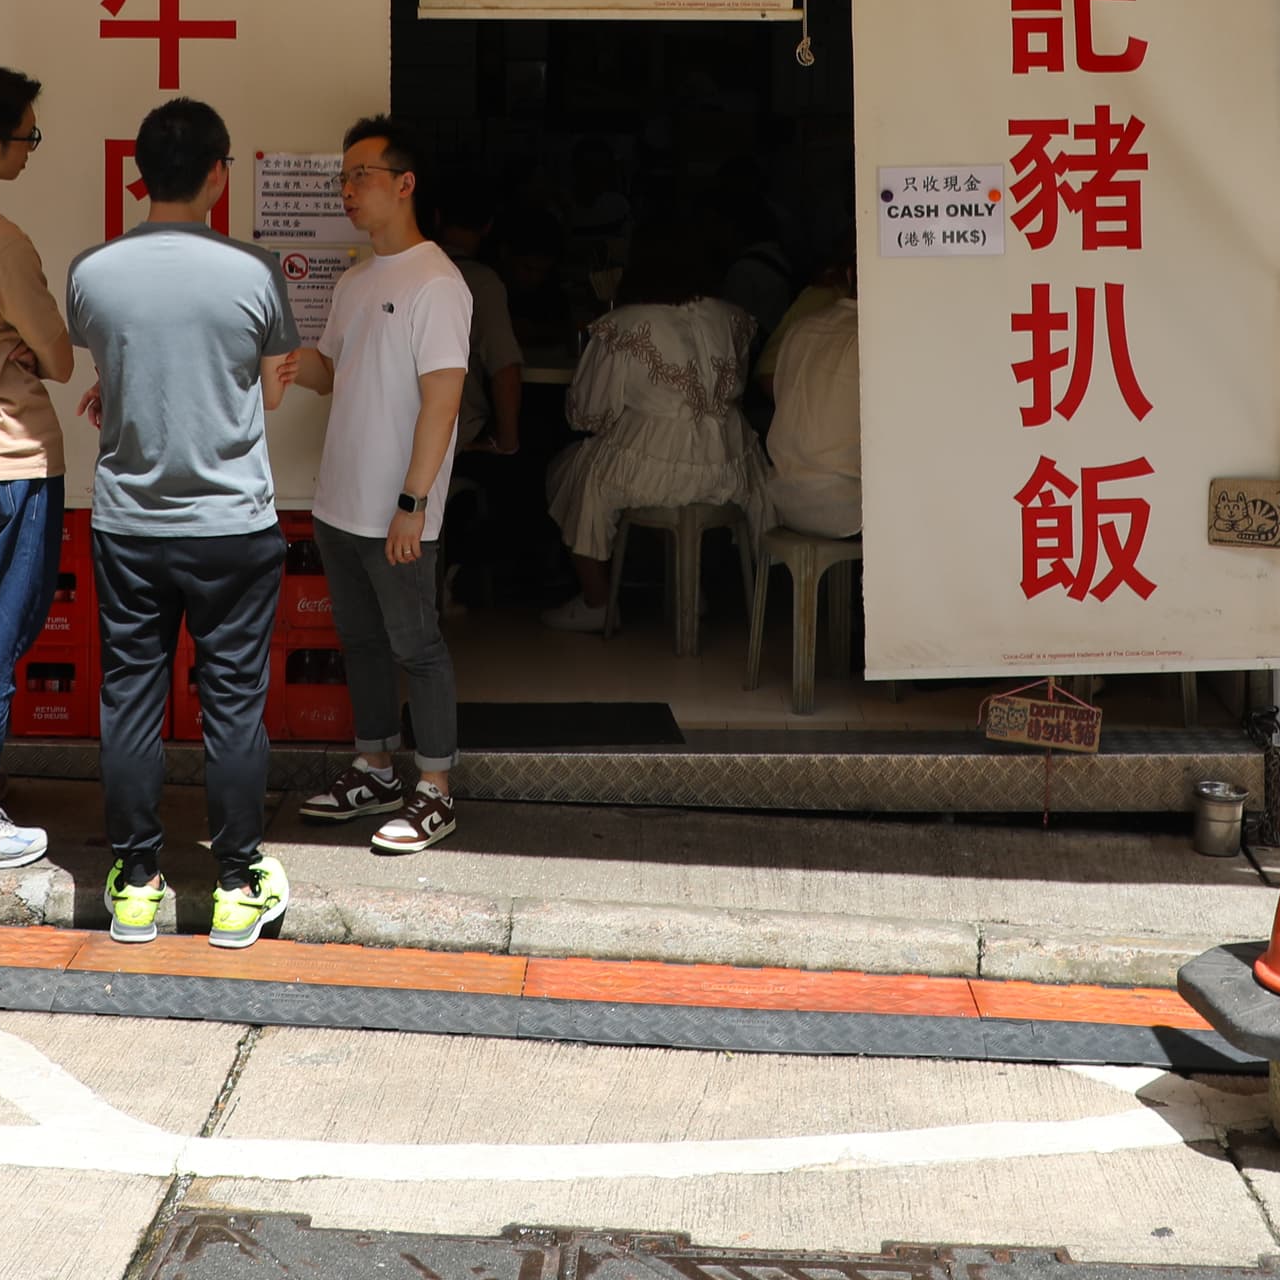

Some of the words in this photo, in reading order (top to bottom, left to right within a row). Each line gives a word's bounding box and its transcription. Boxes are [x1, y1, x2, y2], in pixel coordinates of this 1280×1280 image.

[903, 174, 982, 193] 只收現金
[887, 205, 939, 219] CASH
[945, 203, 997, 218] ONLY
